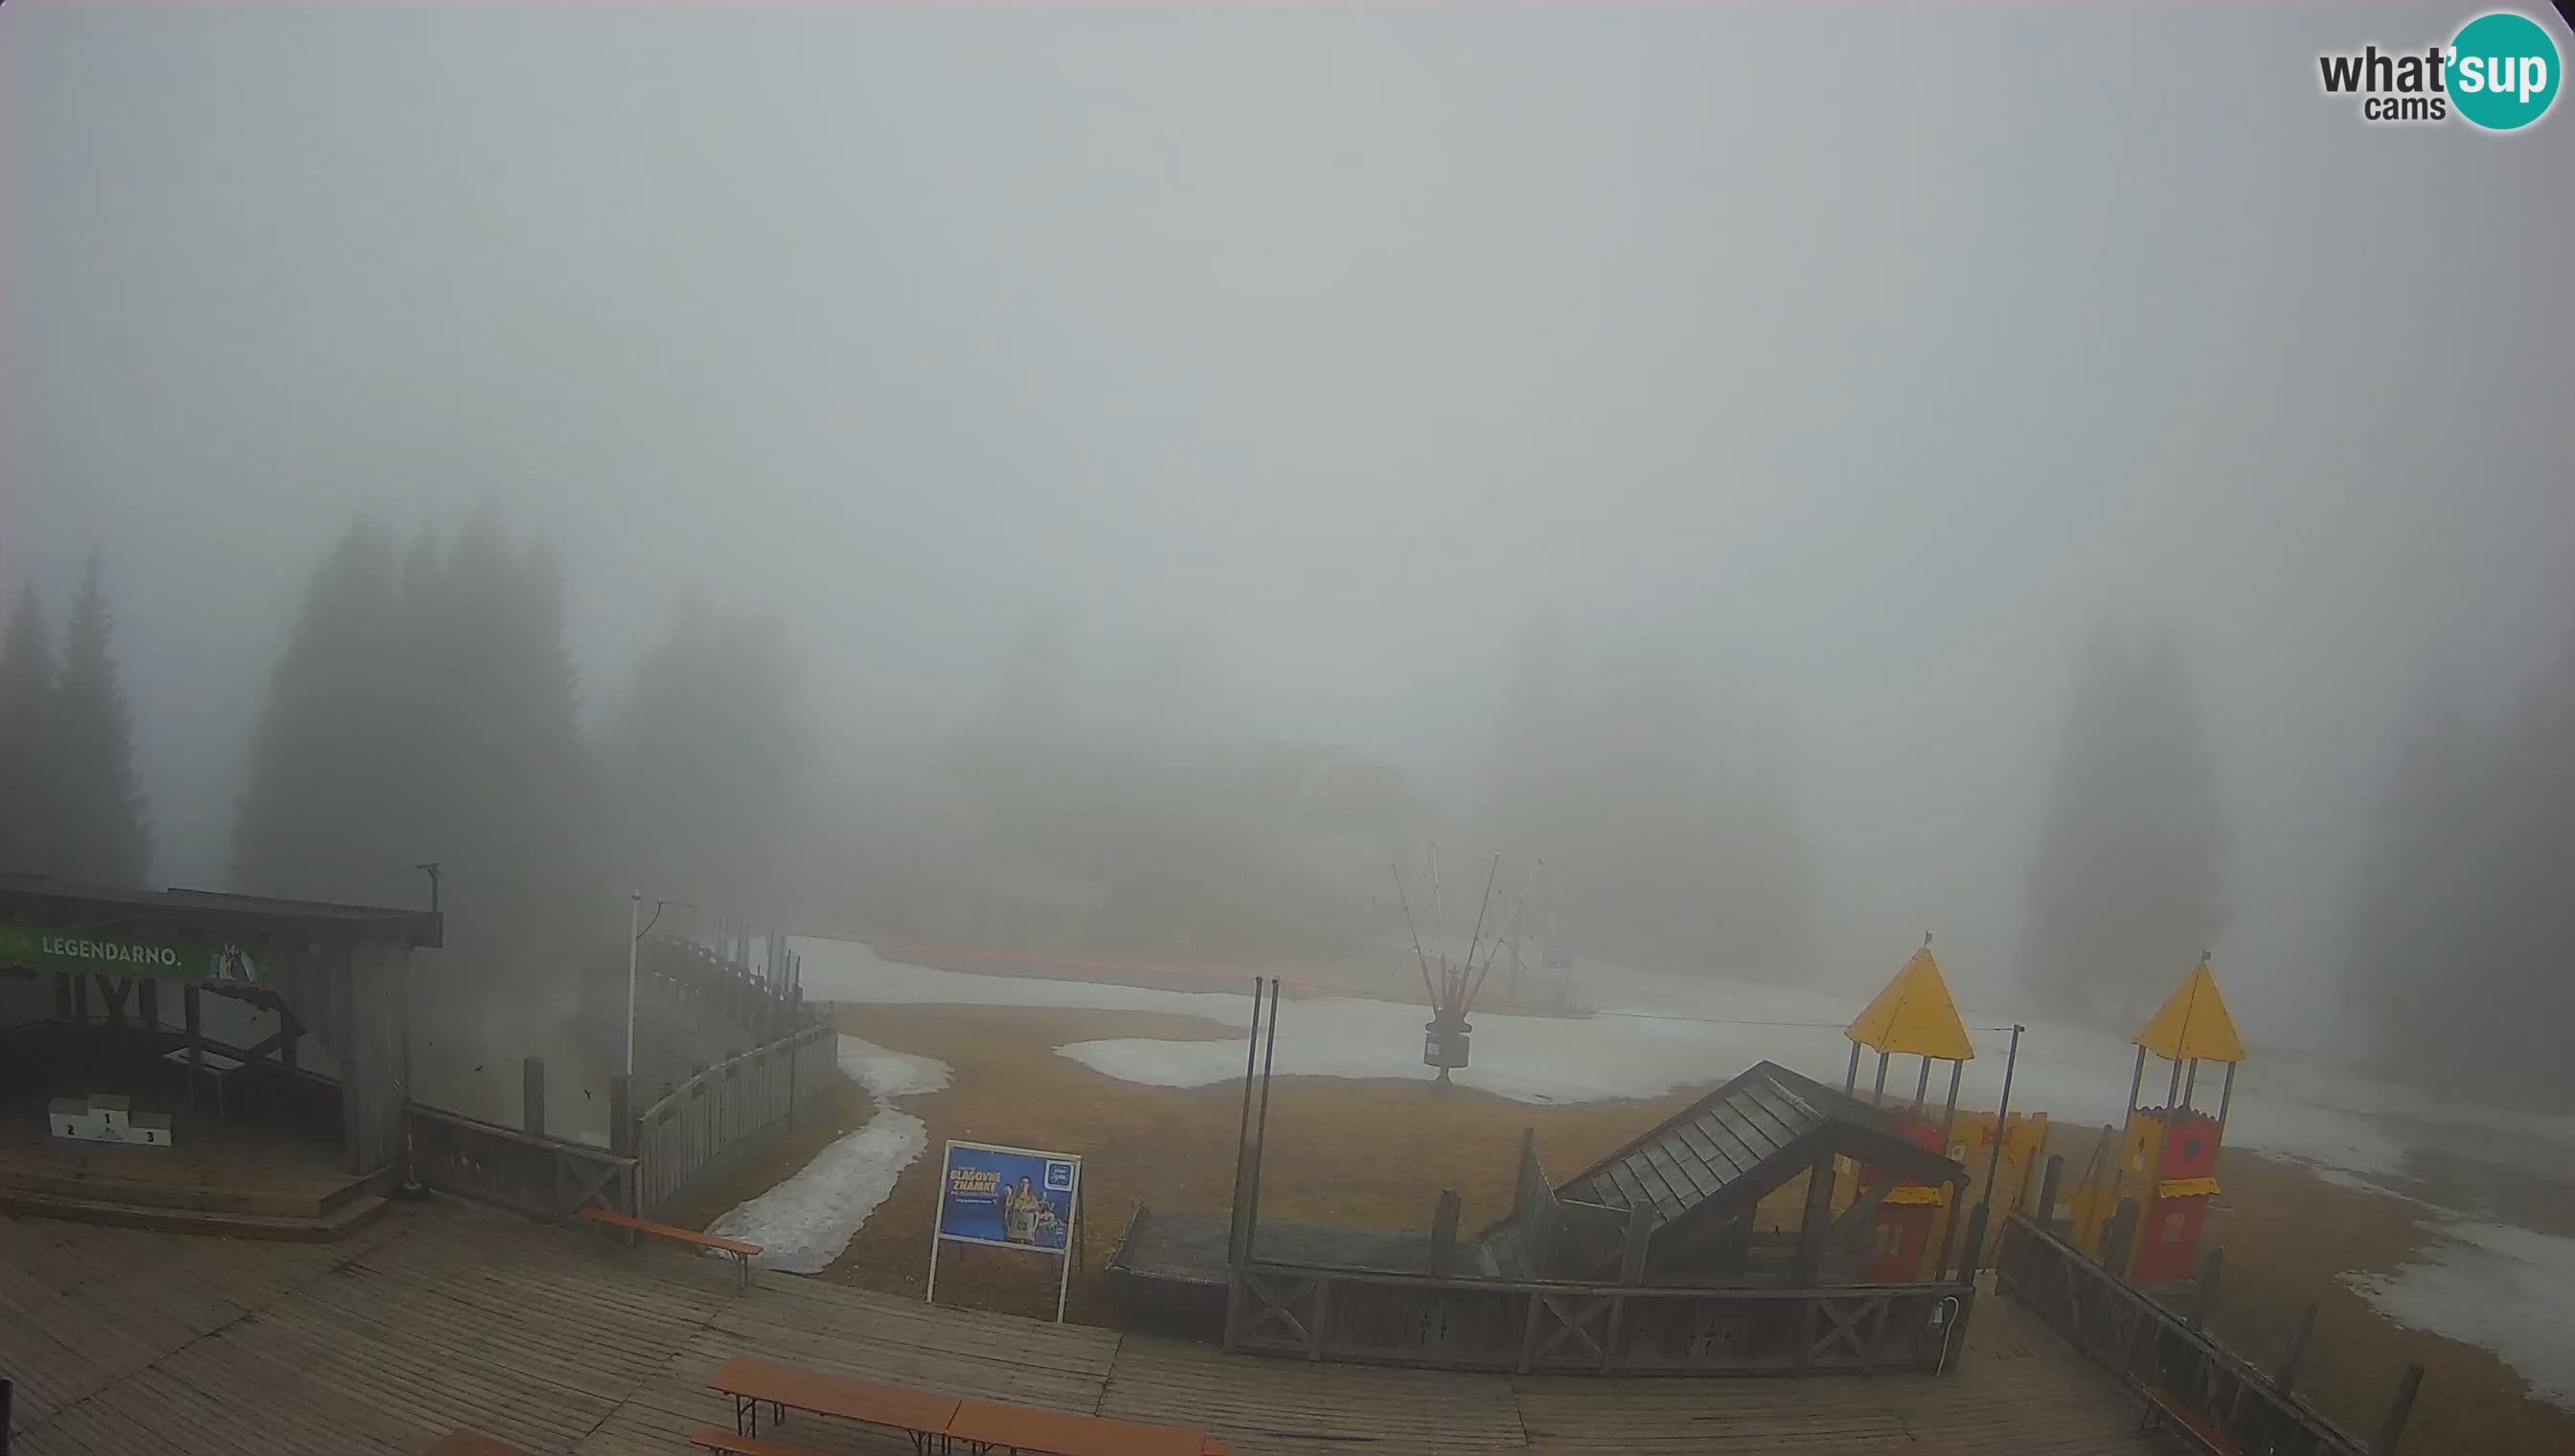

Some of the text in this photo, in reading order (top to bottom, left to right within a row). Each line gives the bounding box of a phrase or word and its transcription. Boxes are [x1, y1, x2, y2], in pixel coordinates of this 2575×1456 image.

[41, 936, 183, 967] LEGENDARNO.
[104, 1113, 111, 1125] 1
[67, 1124, 75, 1136] 2
[146, 1130, 154, 1143] 3
[952, 1180, 997, 1193] ZNAMKE
